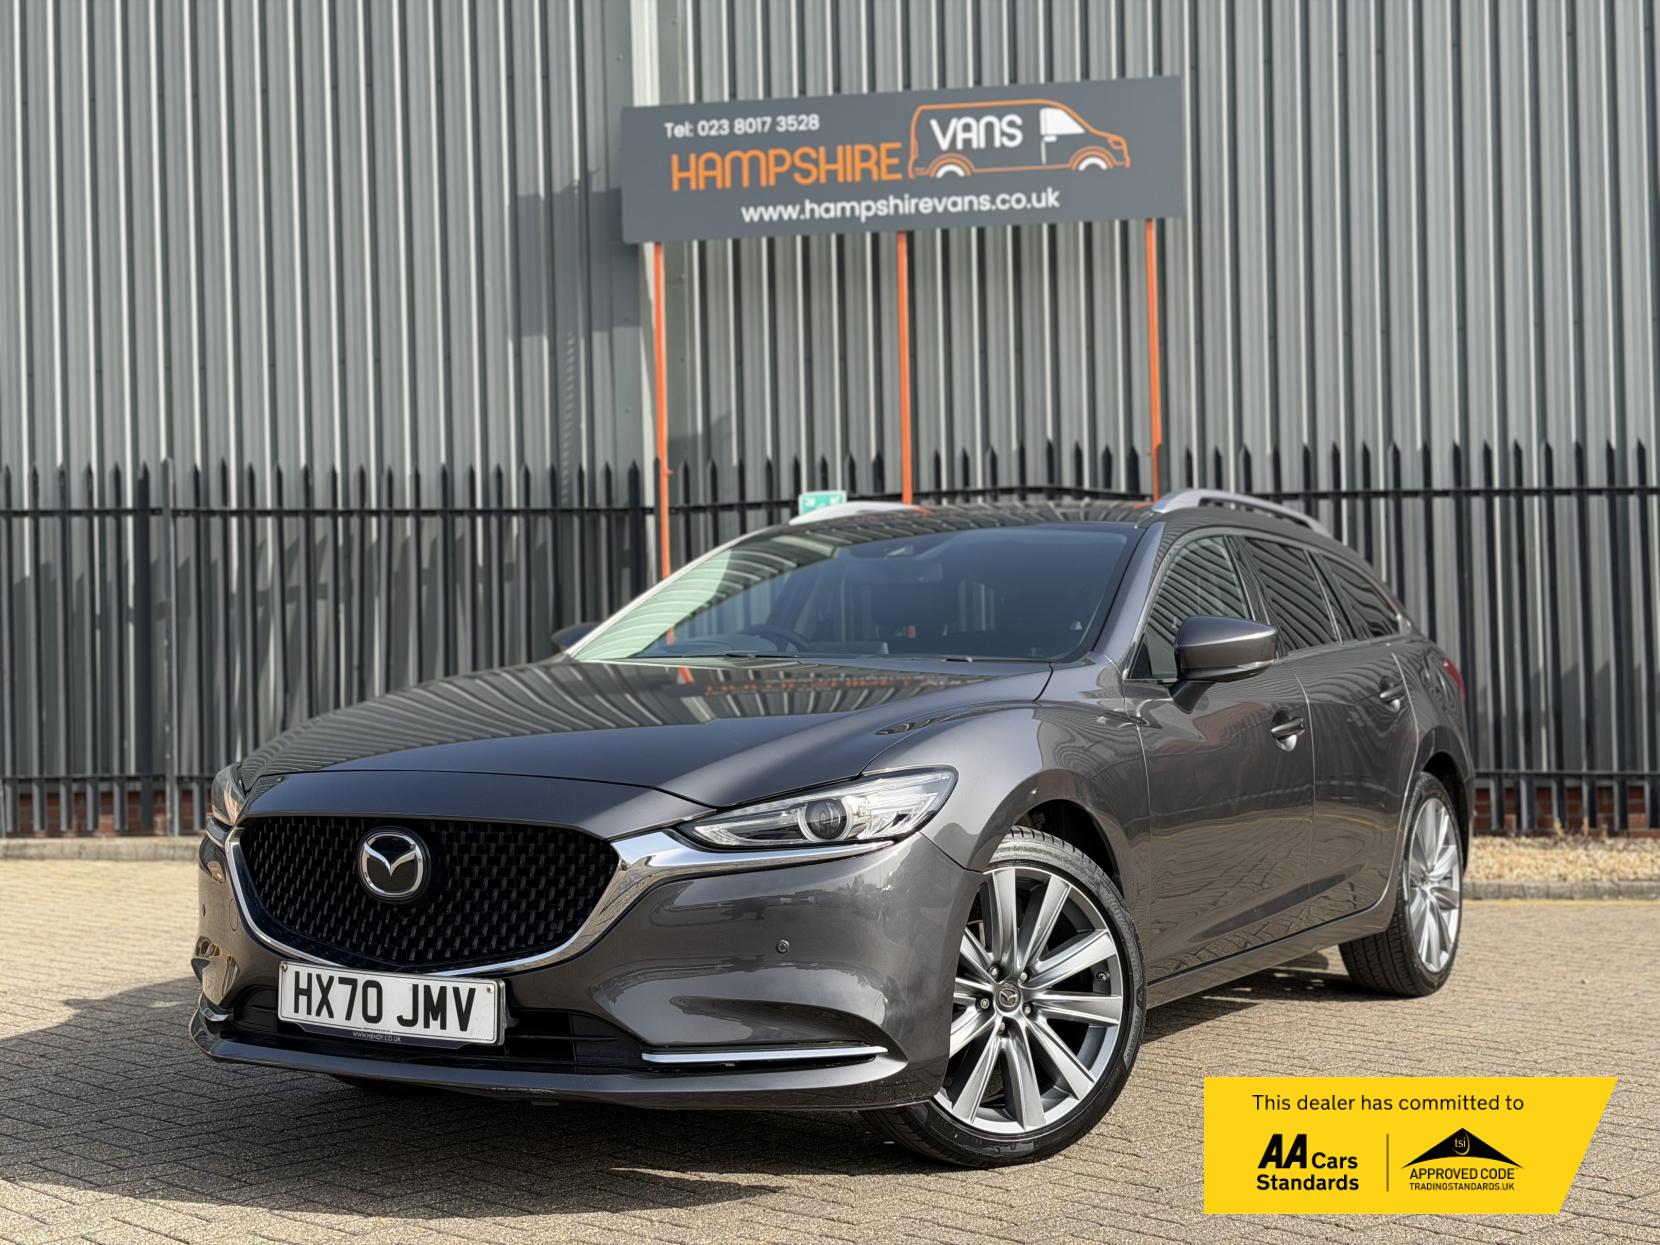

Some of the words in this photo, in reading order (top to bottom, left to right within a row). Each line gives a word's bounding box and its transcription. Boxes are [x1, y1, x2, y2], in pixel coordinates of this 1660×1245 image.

[664, 122, 694, 139] Tel:
[697, 119, 730, 137] 023
[733, 117, 772, 135] 8017
[775, 113, 820, 132] 3528
[671, 141, 903, 192] HAMPSHIRE
[929, 113, 1023, 151] VANS
[741, 186, 1060, 223] www.hampshirevans.co.uk
[293, 970, 383, 1024] HX70
[396, 983, 476, 1032] JMV
